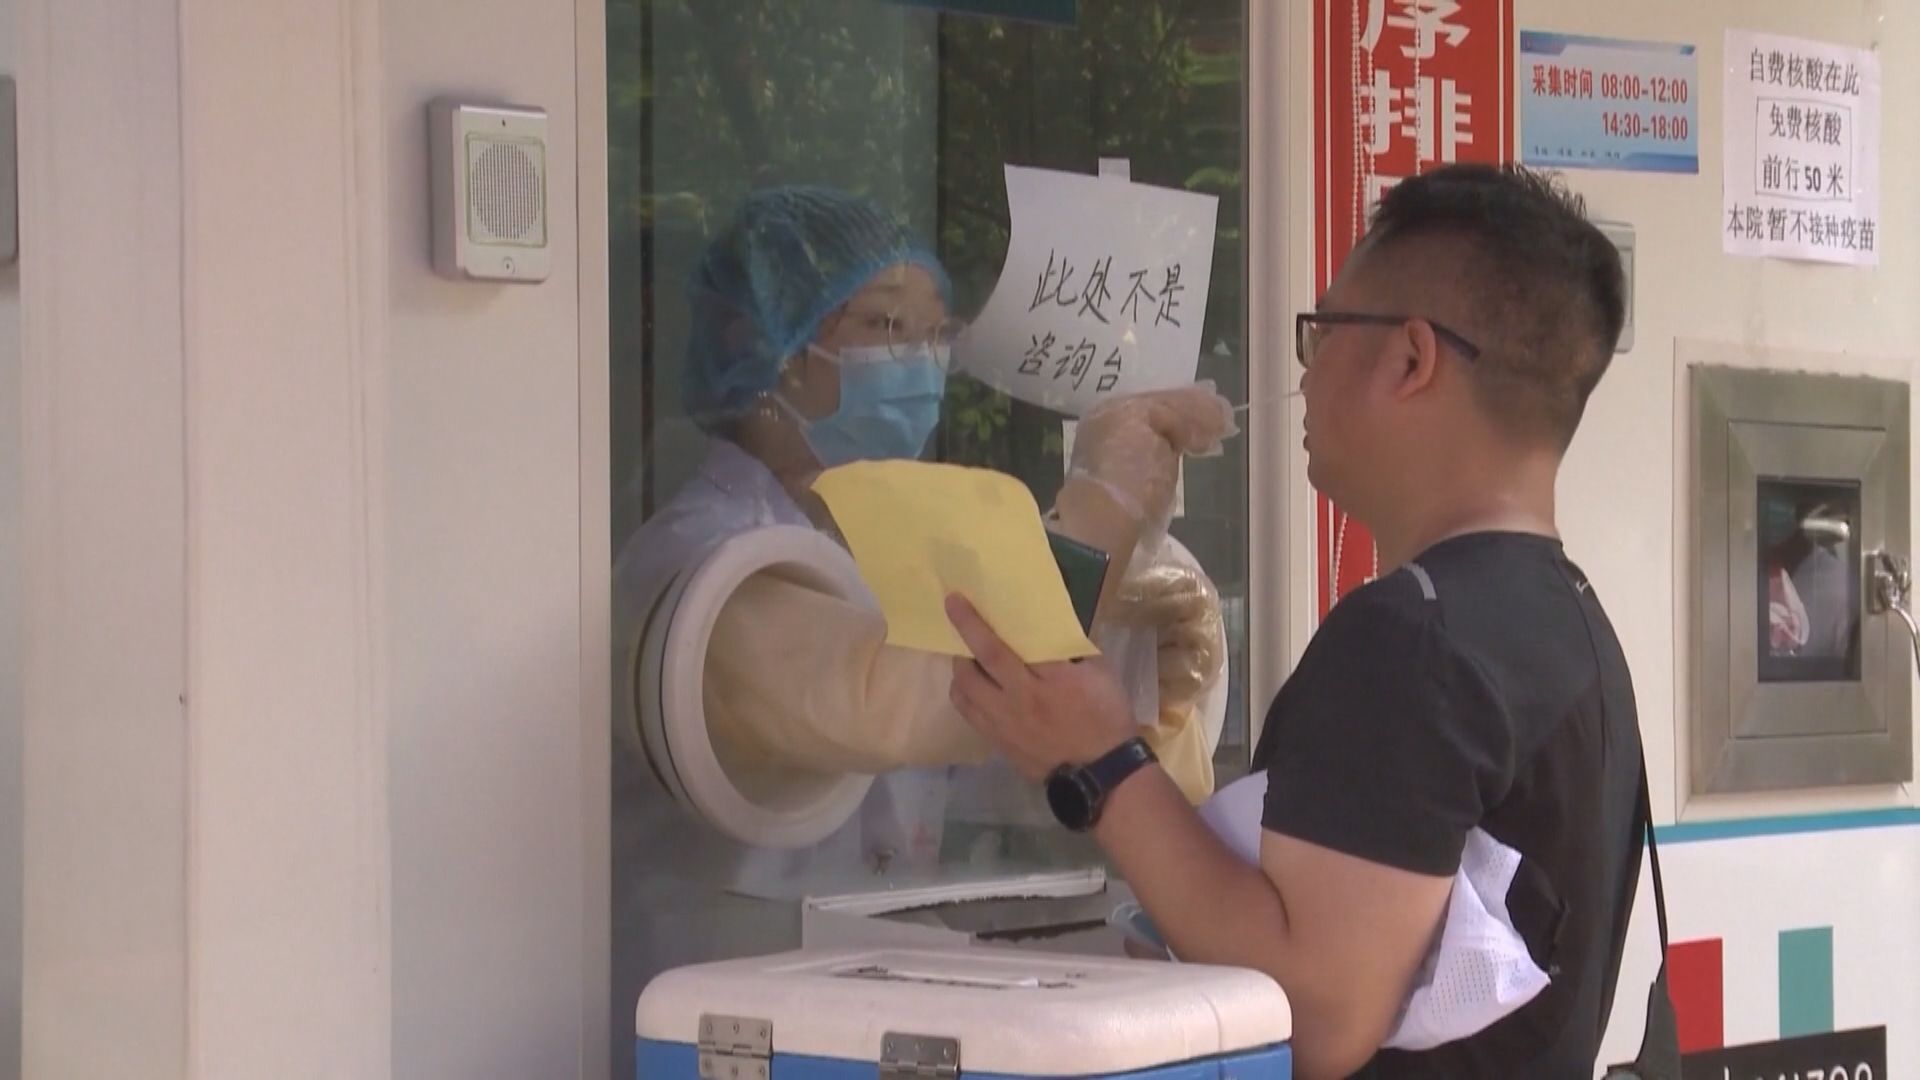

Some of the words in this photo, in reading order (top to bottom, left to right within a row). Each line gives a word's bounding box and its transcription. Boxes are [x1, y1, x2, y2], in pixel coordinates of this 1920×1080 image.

[1533, 64, 1593, 99] 采集时间
[1601, 73, 1688, 104] 08:00-12:00
[1750, 48, 1859, 96] 自费核酸在此
[1358, 0, 1473, 222] 序排
[1602, 111, 1688, 141] 14:30-18:00
[1769, 102, 1842, 146] 免费核酸
[1727, 202, 1875, 252] 本院暂不接种疫苗
[1028, 248, 1185, 328] 此处不是
[1017, 331, 1122, 393] 咨询台
